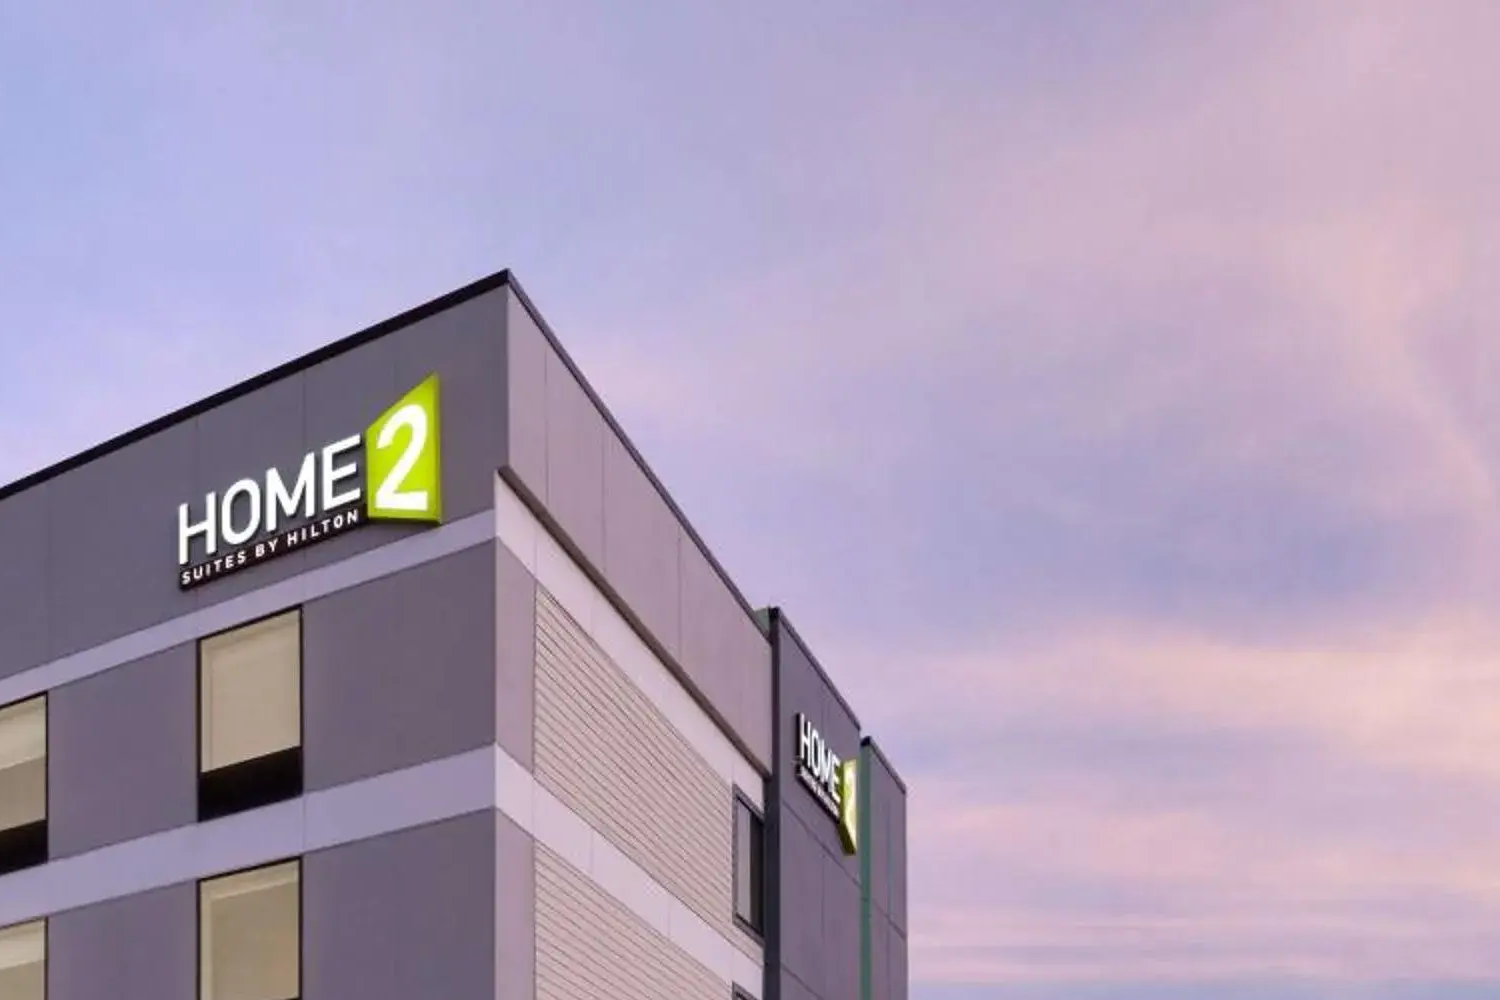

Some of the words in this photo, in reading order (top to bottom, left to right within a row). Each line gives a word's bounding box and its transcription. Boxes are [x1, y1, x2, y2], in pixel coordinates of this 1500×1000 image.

[182, 551, 247, 585] SUITES
[255, 539, 279, 557] BY
[287, 508, 359, 547] HILTON
